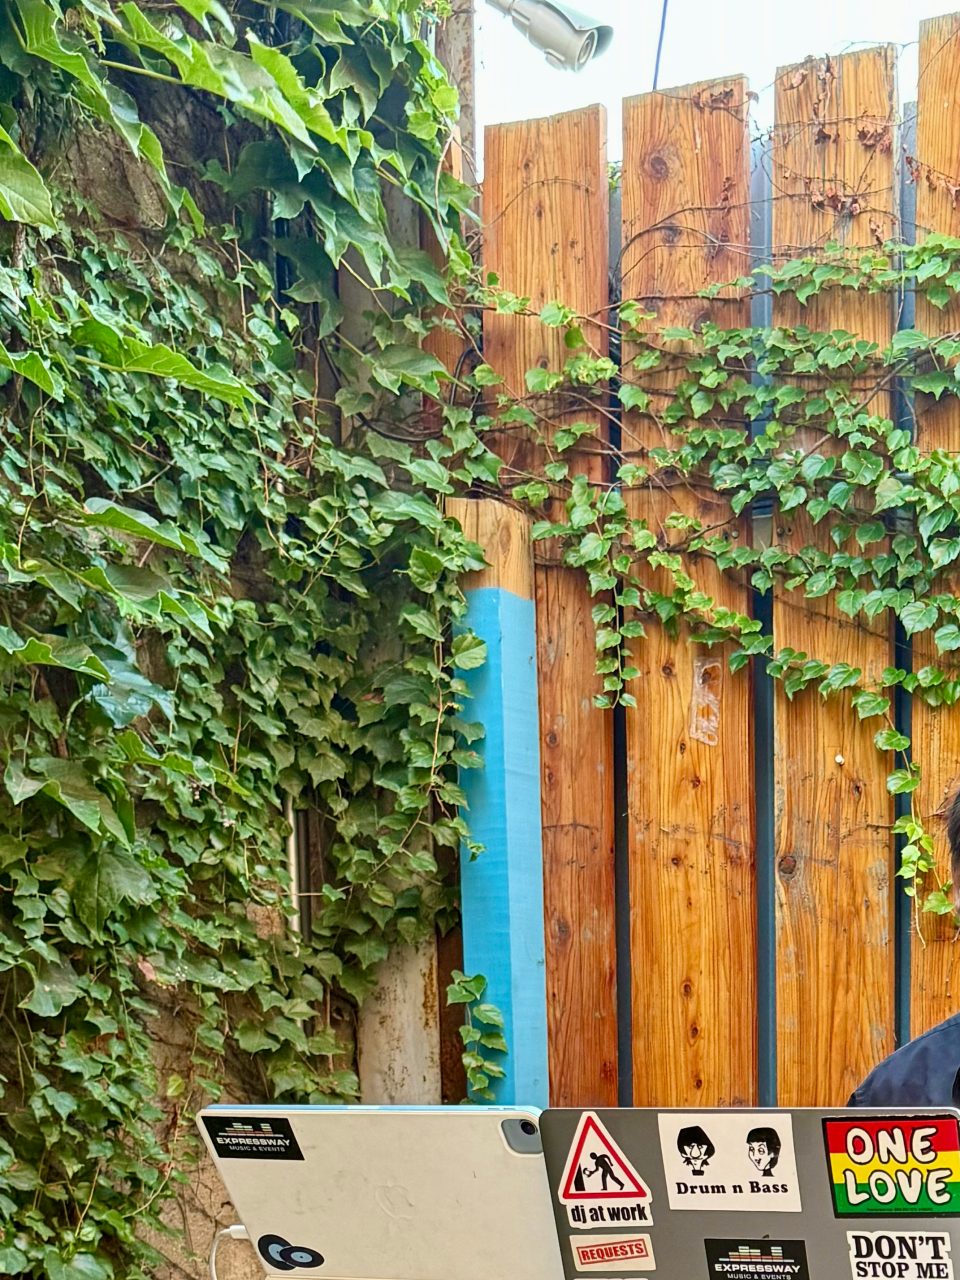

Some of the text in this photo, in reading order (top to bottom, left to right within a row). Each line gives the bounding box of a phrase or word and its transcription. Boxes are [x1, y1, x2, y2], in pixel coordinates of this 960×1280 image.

[216, 1137, 290, 1146] EXPRESSWAY
[846, 1126, 938, 1165] ONE
[675, 1180, 789, 1194] Drum n Bass
[843, 1168, 952, 1206] LOVE
[571, 1203, 648, 1223] dj at work
[581, 1243, 644, 1261] REQUESTS
[852, 1235, 945, 1260] DON'T
[714, 1263, 801, 1273] EXPRESSWAY
[856, 1261, 949, 1279] STOP ME
